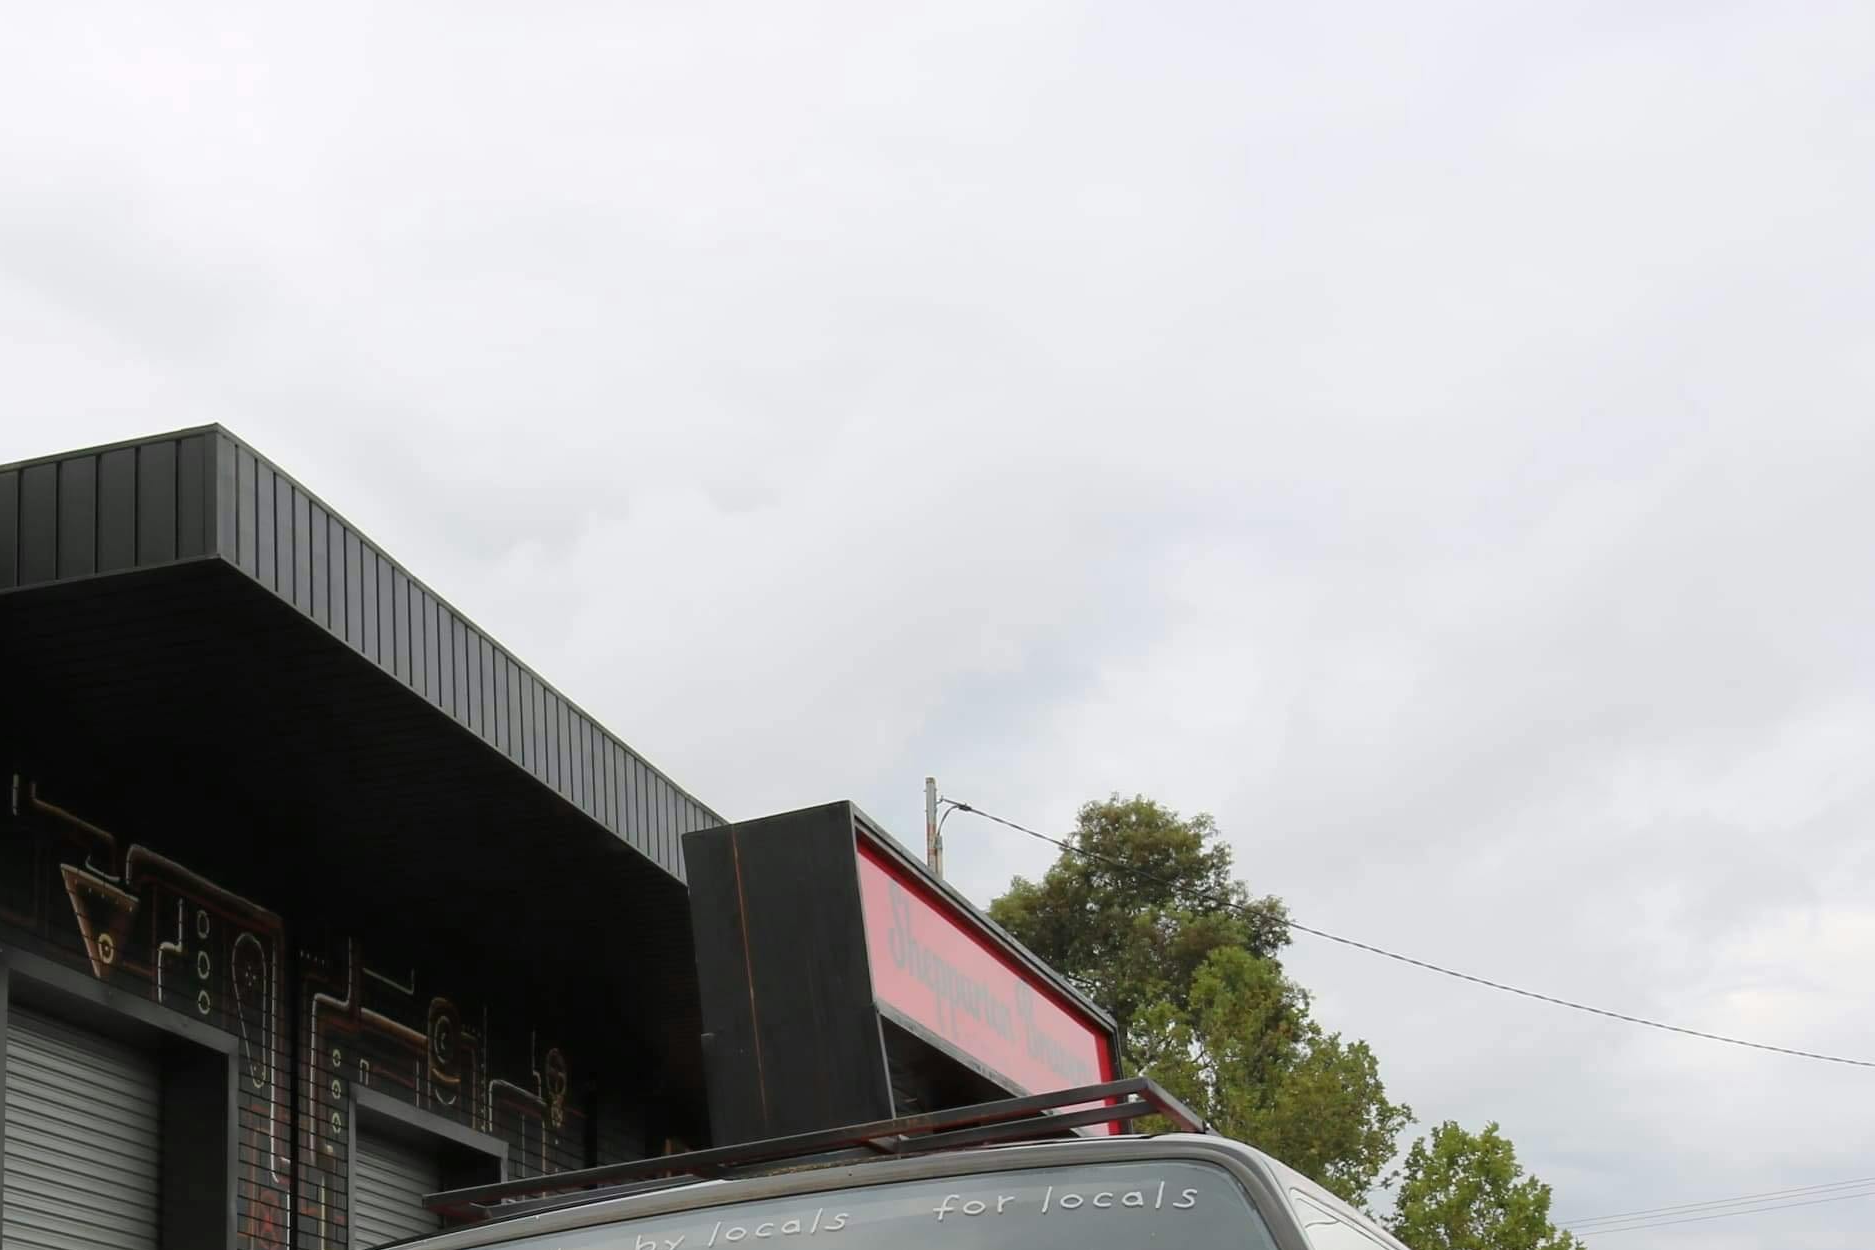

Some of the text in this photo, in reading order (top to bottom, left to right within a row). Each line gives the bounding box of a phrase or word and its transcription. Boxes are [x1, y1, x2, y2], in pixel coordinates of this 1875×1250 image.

[707, 1207, 851, 1248] locals
[932, 1193, 1016, 1222] for
[1041, 1180, 1199, 1214] locals
